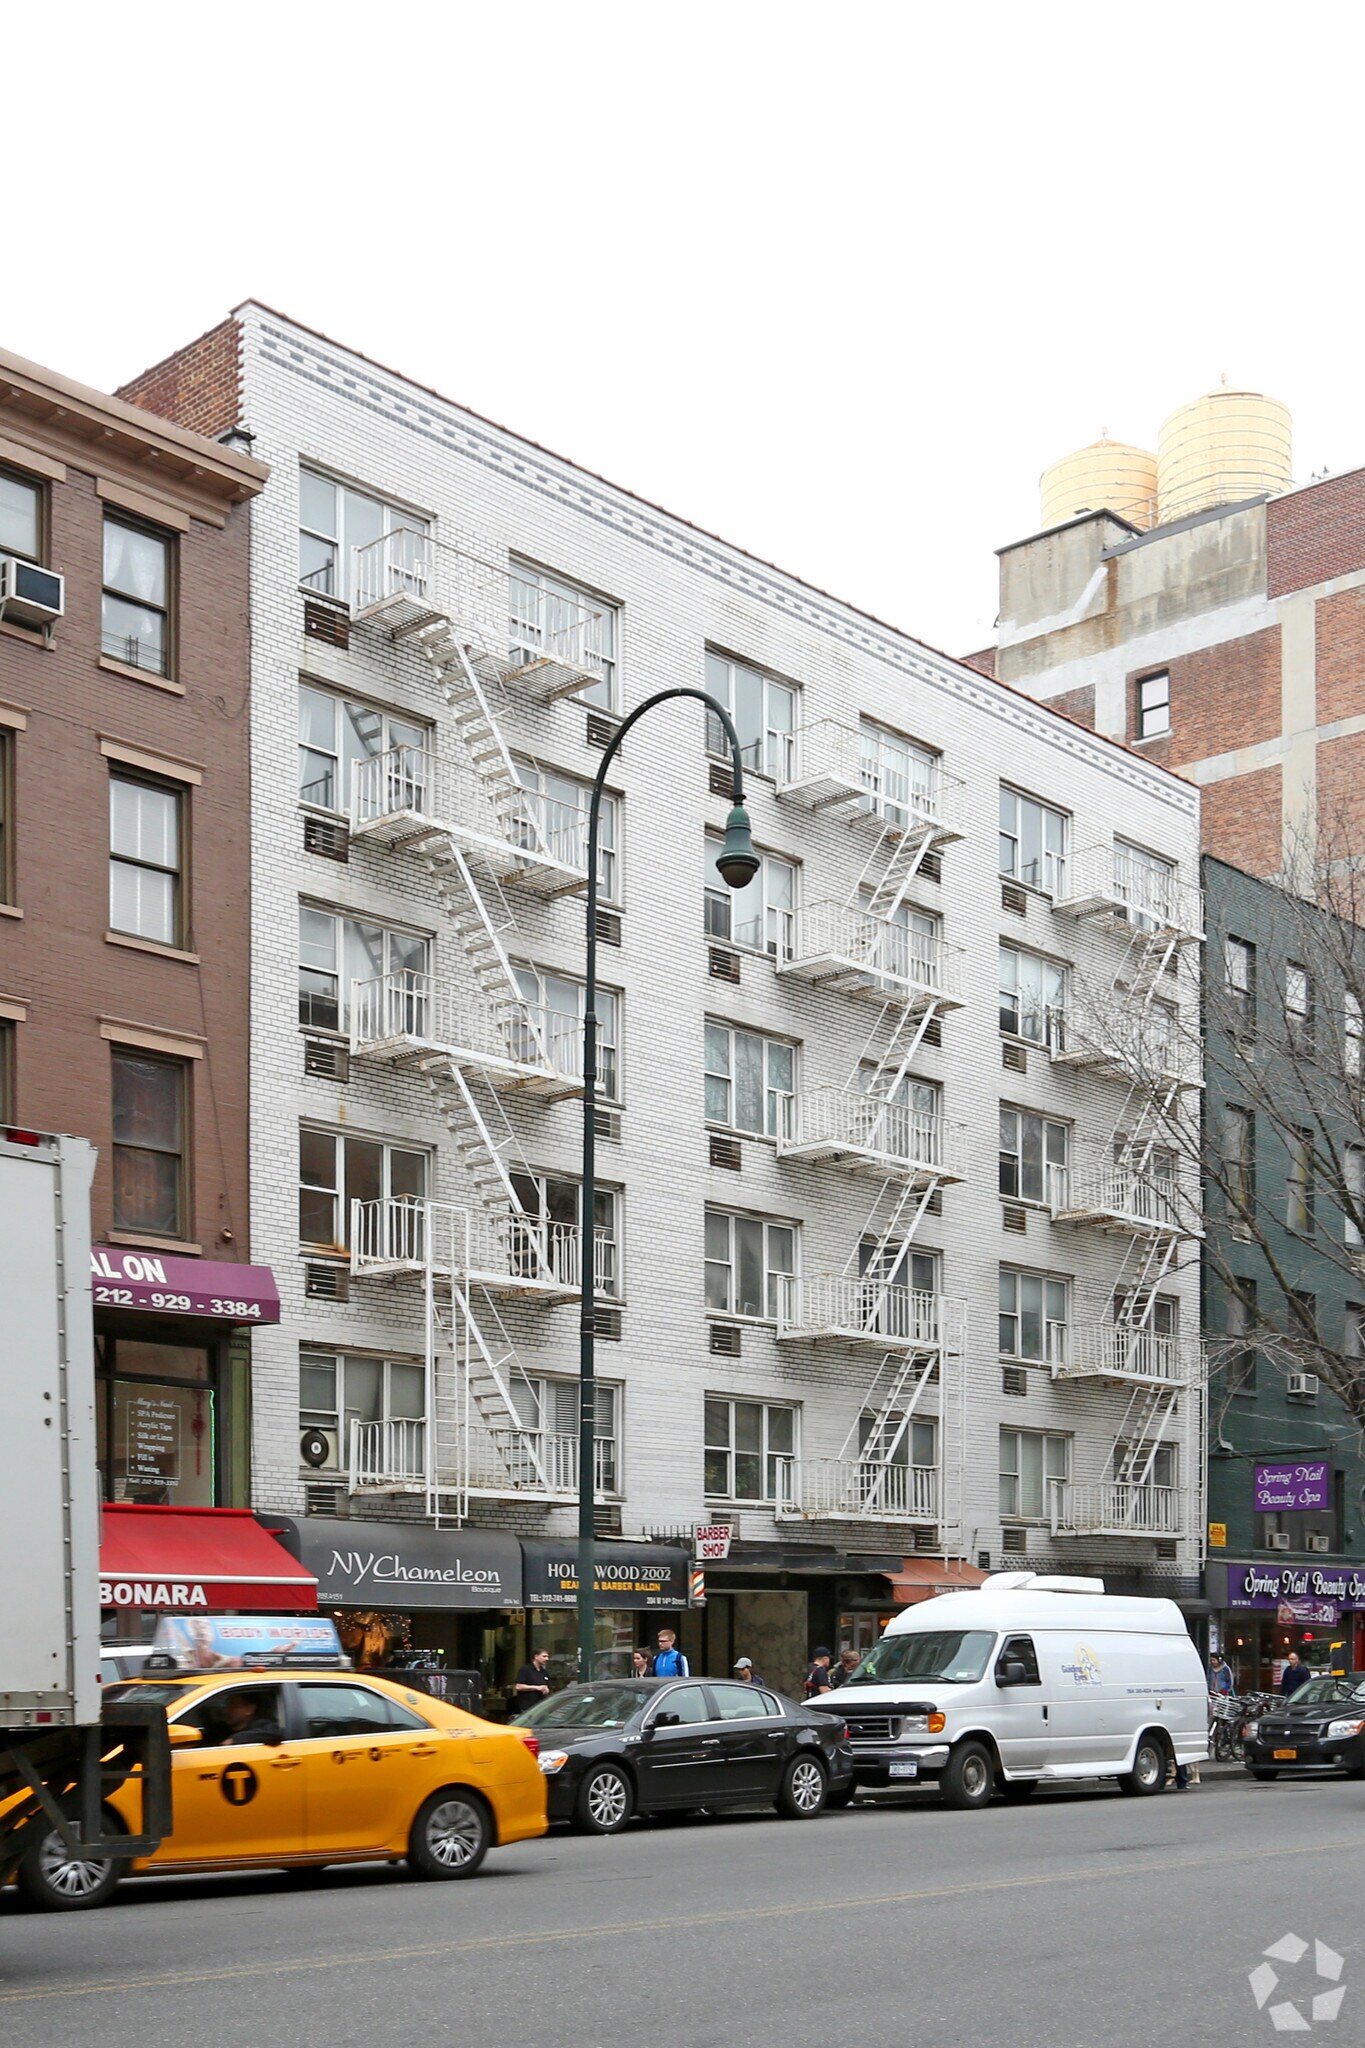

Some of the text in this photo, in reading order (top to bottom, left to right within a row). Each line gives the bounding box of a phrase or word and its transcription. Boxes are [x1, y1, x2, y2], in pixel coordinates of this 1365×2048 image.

[95, 1287, 133, 1305] 212
[151, 1293, 191, 1310] 929
[210, 1299, 261, 1317] 3384
[1258, 1467, 1324, 1486] Spring Nail
[1258, 1488, 1321, 1506] Beauty Spa
[697, 1526, 730, 1541] BARBER
[703, 1543, 725, 1557] SHOP
[548, 1563, 671, 1580] HOLWOOD 2002
[471, 1585, 502, 1593] Boutique
[601, 1582, 634, 1591] BARBER
[635, 1583, 661, 1591] SALON
[1244, 1568, 1280, 1598] Spring
[1282, 1570, 1308, 1594] Nail
[1312, 1571, 1347, 1601] Beauty
[100, 1583, 208, 1605] BONARA
